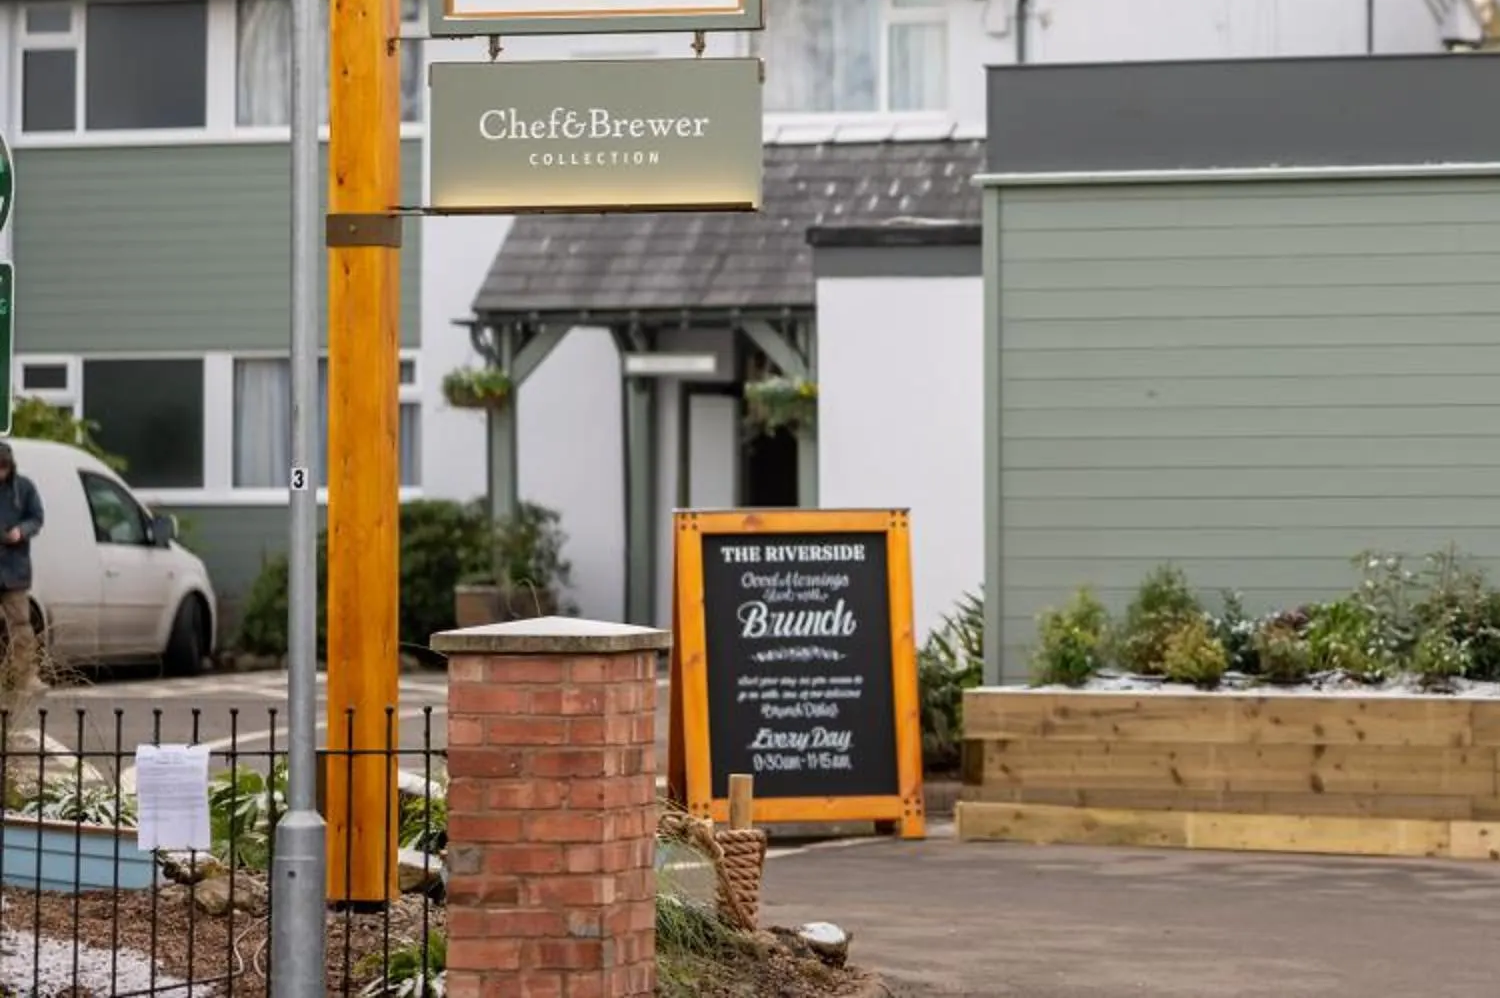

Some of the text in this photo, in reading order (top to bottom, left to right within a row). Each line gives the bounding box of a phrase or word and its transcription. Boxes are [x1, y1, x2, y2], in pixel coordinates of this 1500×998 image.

[478, 106, 710, 140] Chef&Brewer
[528, 151, 660, 166] COLLECTION
[293, 469, 304, 489] 3
[720, 543, 866, 563] THE RIVERSIDE
[737, 598, 857, 638] Brunch
[752, 726, 852, 752] Every Day
